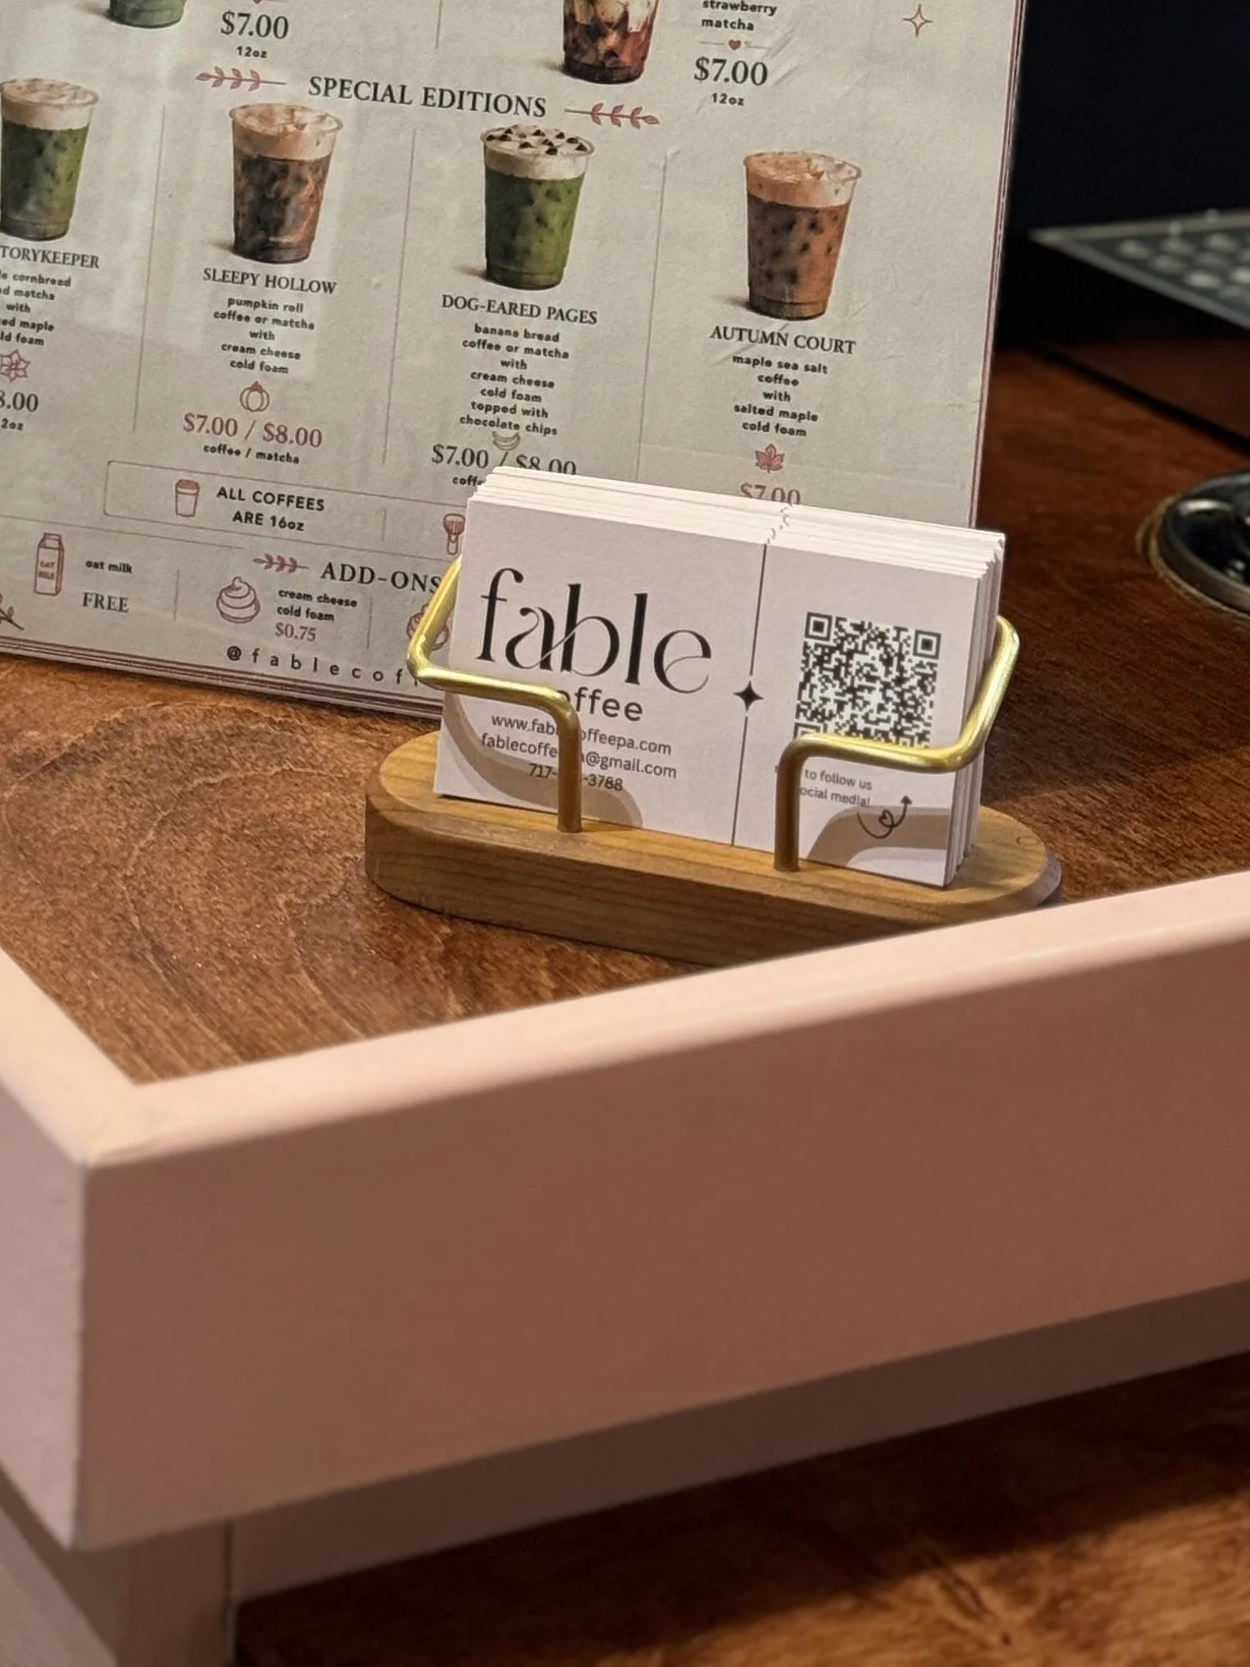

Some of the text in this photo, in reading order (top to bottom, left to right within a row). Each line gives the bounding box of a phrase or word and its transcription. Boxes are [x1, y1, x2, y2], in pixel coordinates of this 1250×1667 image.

[702, 0, 778, 16] strawberry
[220, 10, 289, 40] $7.00
[701, 18, 755, 31] matcha
[236, 46, 268, 59] 12oz
[694, 56, 768, 86] $7.00
[308, 75, 547, 118] SPECIAL EDITIONS
[711, 93, 745, 106] 12oz
[12, 272, 72, 287] cornbread
[202, 267, 337, 295] SLEEPY HOLLOW
[14, 288, 55, 301] matcha
[6, 302, 31, 313] with
[227, 297, 303, 313] pumpkin roll
[442, 294, 598, 325] DOG-EARED PAGES
[19, 320, 54, 333] maple
[213, 310, 315, 330] coffee or matcha
[16, 333, 44, 346] foam
[249, 330, 275, 341] with
[474, 323, 560, 343] banana bread
[709, 326, 856, 355] AUTUMN COURT
[221, 343, 301, 360] cream cheese
[462, 338, 569, 359] coffee or matcha
[229, 360, 289, 374] cold foam
[500, 358, 528, 370] with
[732, 355, 828, 374] maple sea salt
[470, 371, 555, 388] cream cheese
[757, 374, 800, 386] coffee
[480, 387, 542, 403] cold foam
[763, 390, 791, 402] with
[471, 400, 549, 418] topped with
[734, 404, 819, 423] salted maple
[183, 412, 238, 437] $7.00
[262, 422, 322, 448] $8.00
[459, 415, 558, 436] chocolate chips
[742, 421, 807, 437] cold foam
[203, 444, 241, 457] coffee
[256, 450, 300, 464] matcha
[431, 443, 489, 469] $7.00
[515, 453, 576, 475] $800
[216, 486, 325, 511] ALL COFFEES
[740, 482, 801, 505] $700
[232, 511, 305, 532] ARE 16oz
[85, 560, 133, 573] oat milk
[320, 562, 442, 594] ADD-ONS
[82, 592, 130, 613] FREE
[278, 587, 358, 608] cream cheese
[276, 603, 335, 622] cold foam
[274, 621, 317, 642] $0.75
[475, 567, 712, 694] fable
[557, 686, 642, 722] ffee
[491, 714, 672, 755] www.faboffeepa.com
[481, 732, 677, 779] fablecoffe@gmail.com
[528, 762, 624, 792] 717--3788
[805, 769, 872, 790] to follow us
[799, 786, 870, 807] ocial media!
